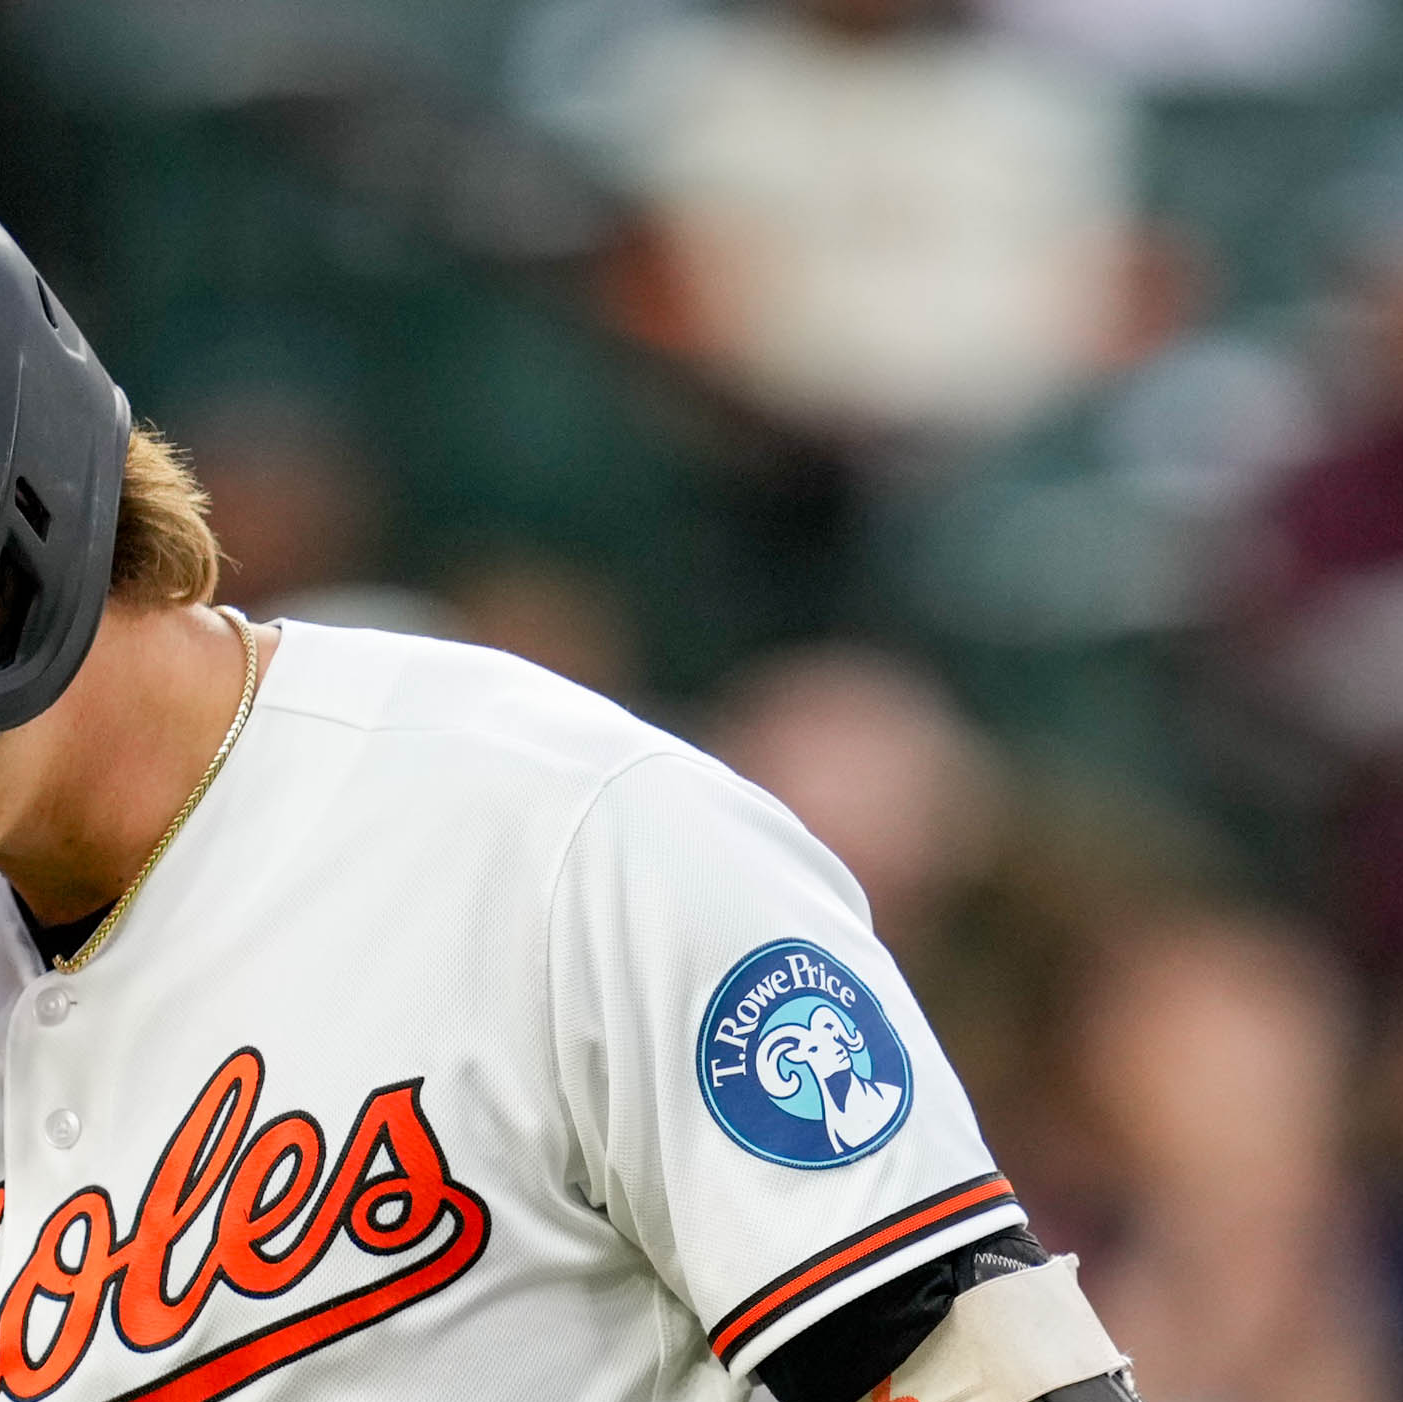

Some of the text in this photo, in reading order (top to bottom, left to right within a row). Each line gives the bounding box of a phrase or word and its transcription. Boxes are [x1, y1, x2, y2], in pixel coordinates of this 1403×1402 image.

[710, 953, 857, 1088] T. Rowe Price
